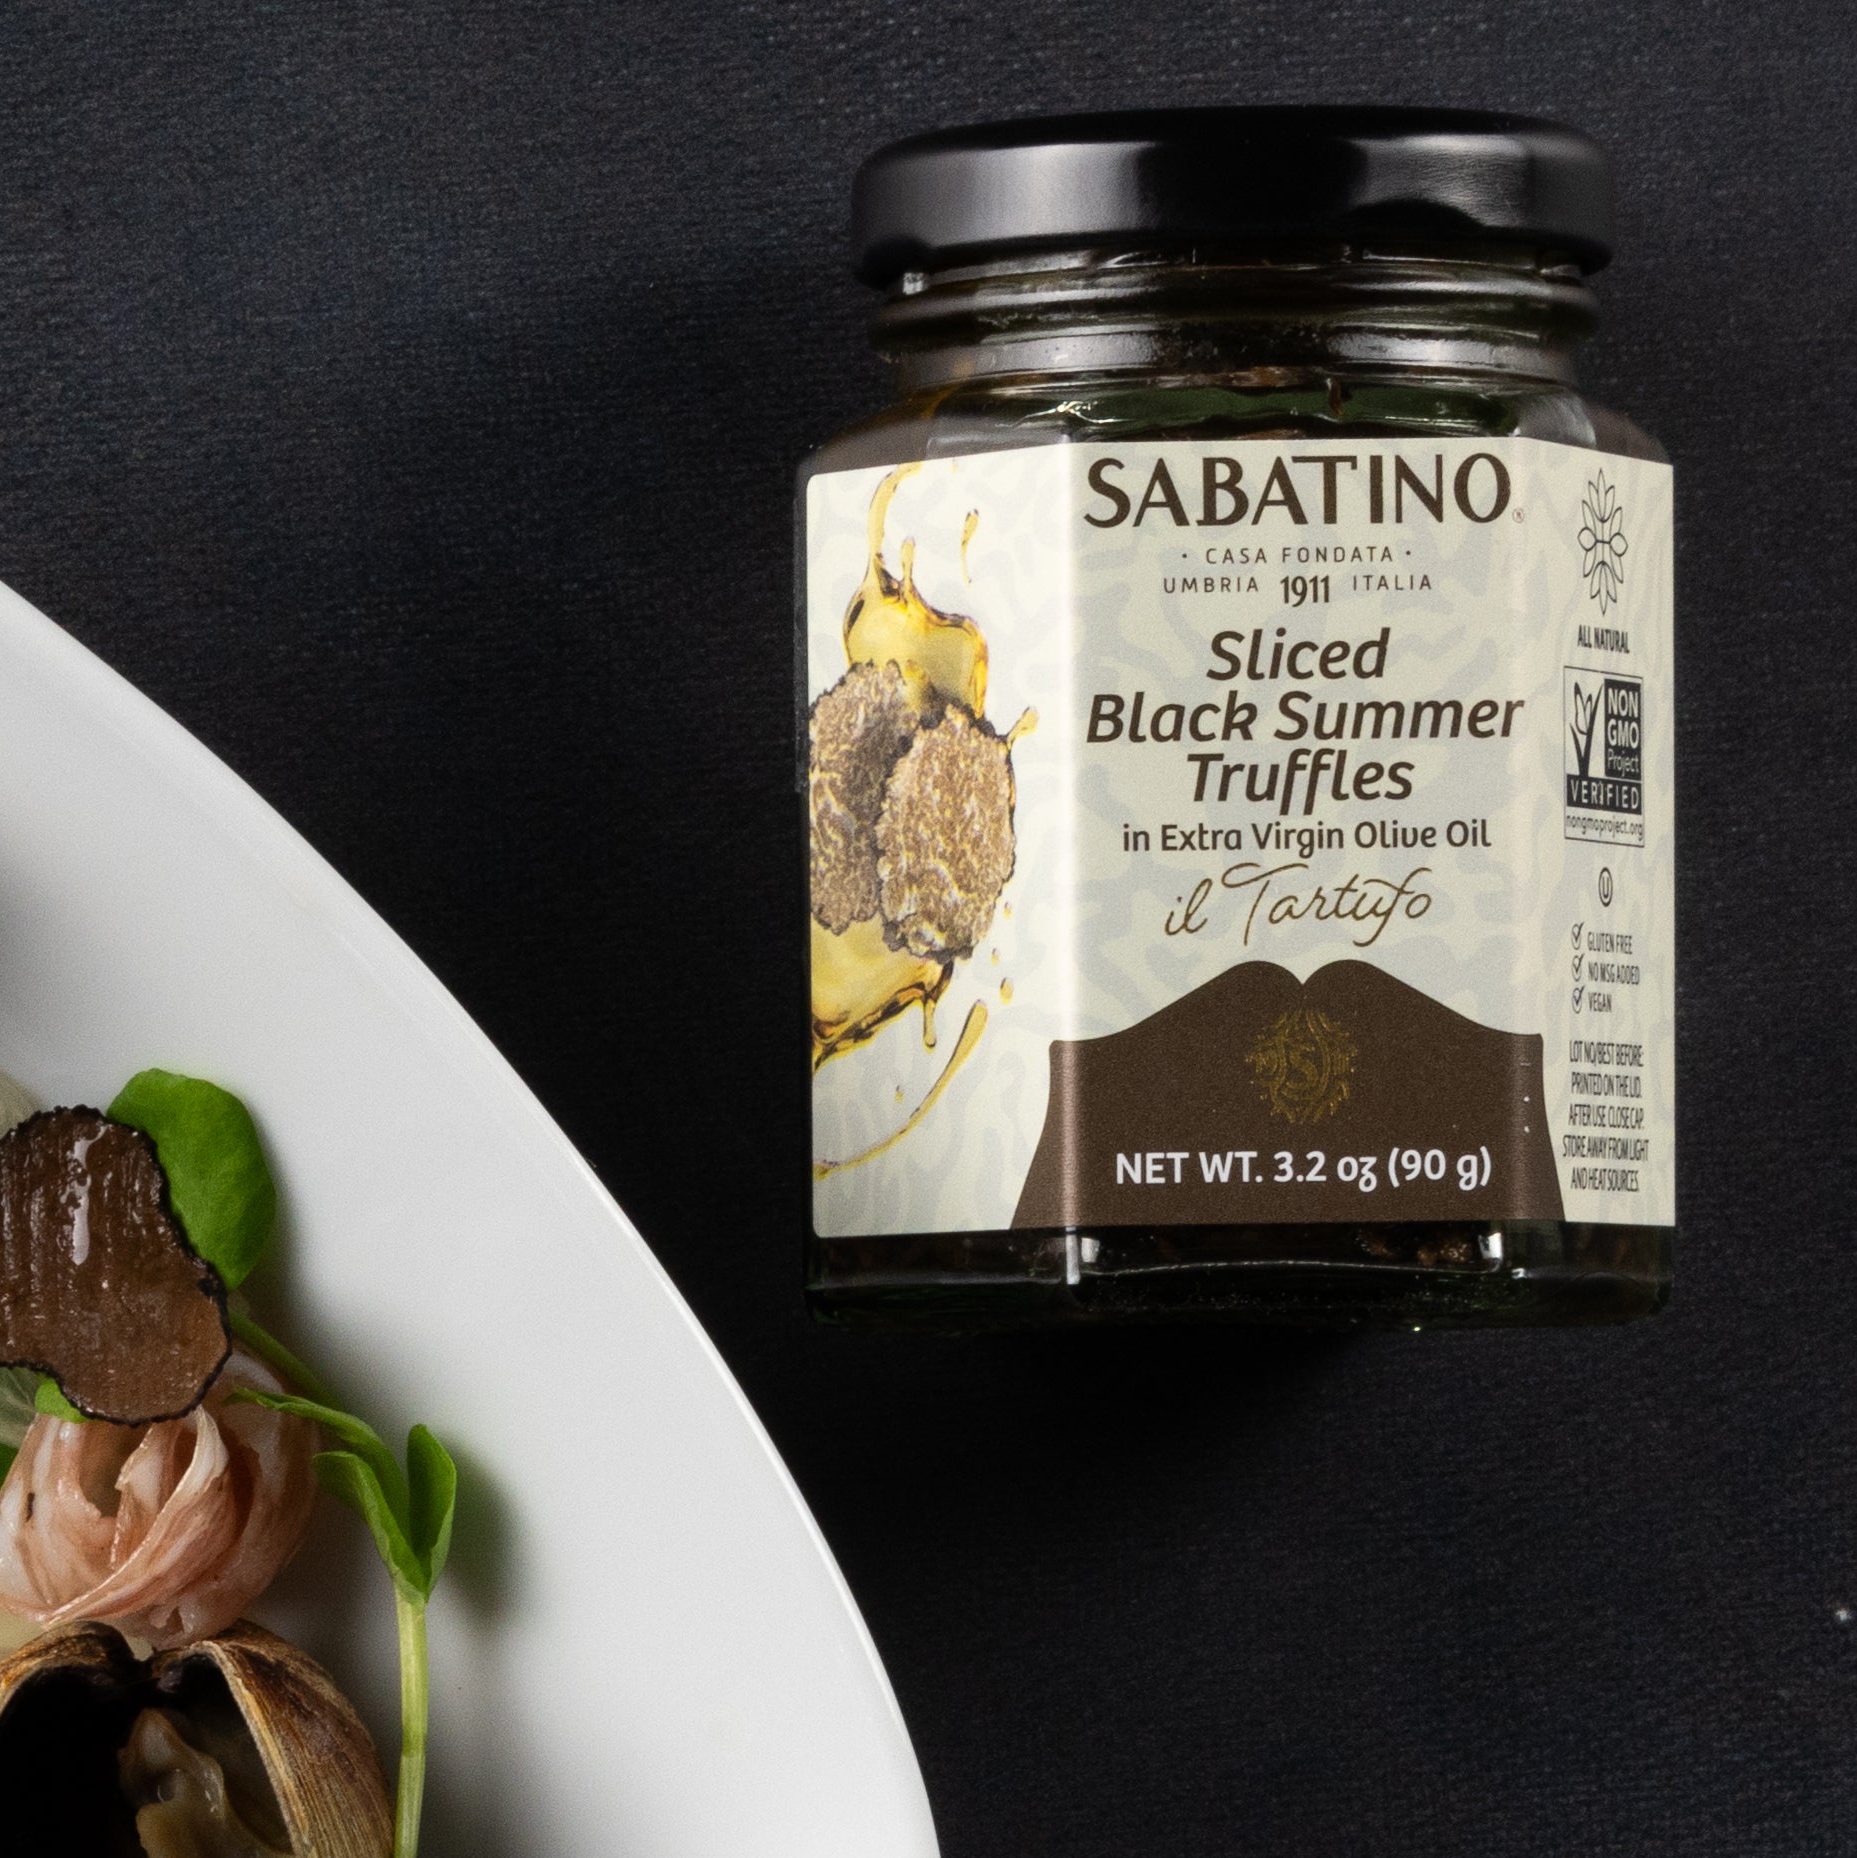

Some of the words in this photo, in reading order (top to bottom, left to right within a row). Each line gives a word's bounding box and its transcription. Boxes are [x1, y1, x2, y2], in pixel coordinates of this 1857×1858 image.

[1083, 452, 1511, 529] SABATINO
[1205, 547, 1268, 565] CASA
[1281, 545, 1394, 564] FONDATA
[1162, 576, 1260, 594] UMBRIA
[1279, 574, 1331, 608] 1911
[1352, 573, 1433, 591] ITALIA
[1205, 626, 1391, 681] Sliced
[1577, 624, 1592, 649] ALL
[1594, 627, 1630, 654] NATURAL
[1086, 689, 1259, 743] Black
[1274, 690, 1526, 742] Summer
[1607, 687, 1639, 718] NON
[1607, 718, 1639, 749] GMO
[1607, 748, 1639, 777] Project
[1186, 747, 1415, 816] Truffles
[1570, 779, 1640, 810] VERIFIED
[1122, 823, 1150, 851] in
[1160, 822, 1243, 851] Extra
[1251, 821, 1344, 859] Virgin
[1353, 820, 1438, 849] Olive
[1445, 818, 1492, 848] Oil
[1163, 877, 1214, 936] il
[1220, 862, 1433, 947] Tartufo
[1587, 931, 1615, 953] GLUTEN
[1616, 933, 1633, 955] FREE
[1588, 961, 1599, 982] NO
[1600, 962, 1615, 983] MSG
[1616, 964, 1640, 985] ADDED
[1588, 992, 1612, 1013] VEGAN
[1569, 1039, 1583, 1063] LOT
[1571, 1071, 1602, 1096] PRINTED
[1603, 1073, 1614, 1096] ON
[1615, 1075, 1628, 1097] THE
[1568, 1103, 1592, 1127] AFTER
[1593, 1105, 1606, 1128] USE
[1608, 1106, 1629, 1129] CLOSE
[1562, 1134, 1586, 1158] STORE
[1586, 1135, 1608, 1160] AWAY
[1608, 1136, 1629, 1161] FROM
[1629, 1138, 1650, 1163] LIGHT
[1115, 1151, 1190, 1186] NET
[1198, 1150, 1263, 1185] WT.
[1272, 1150, 1328, 1184] 3.2
[1387, 1146, 1447, 1189] (90
[1455, 1145, 1493, 1192] g)
[1570, 1166, 1588, 1190] AND
[1588, 1167, 1607, 1191] HEAT
